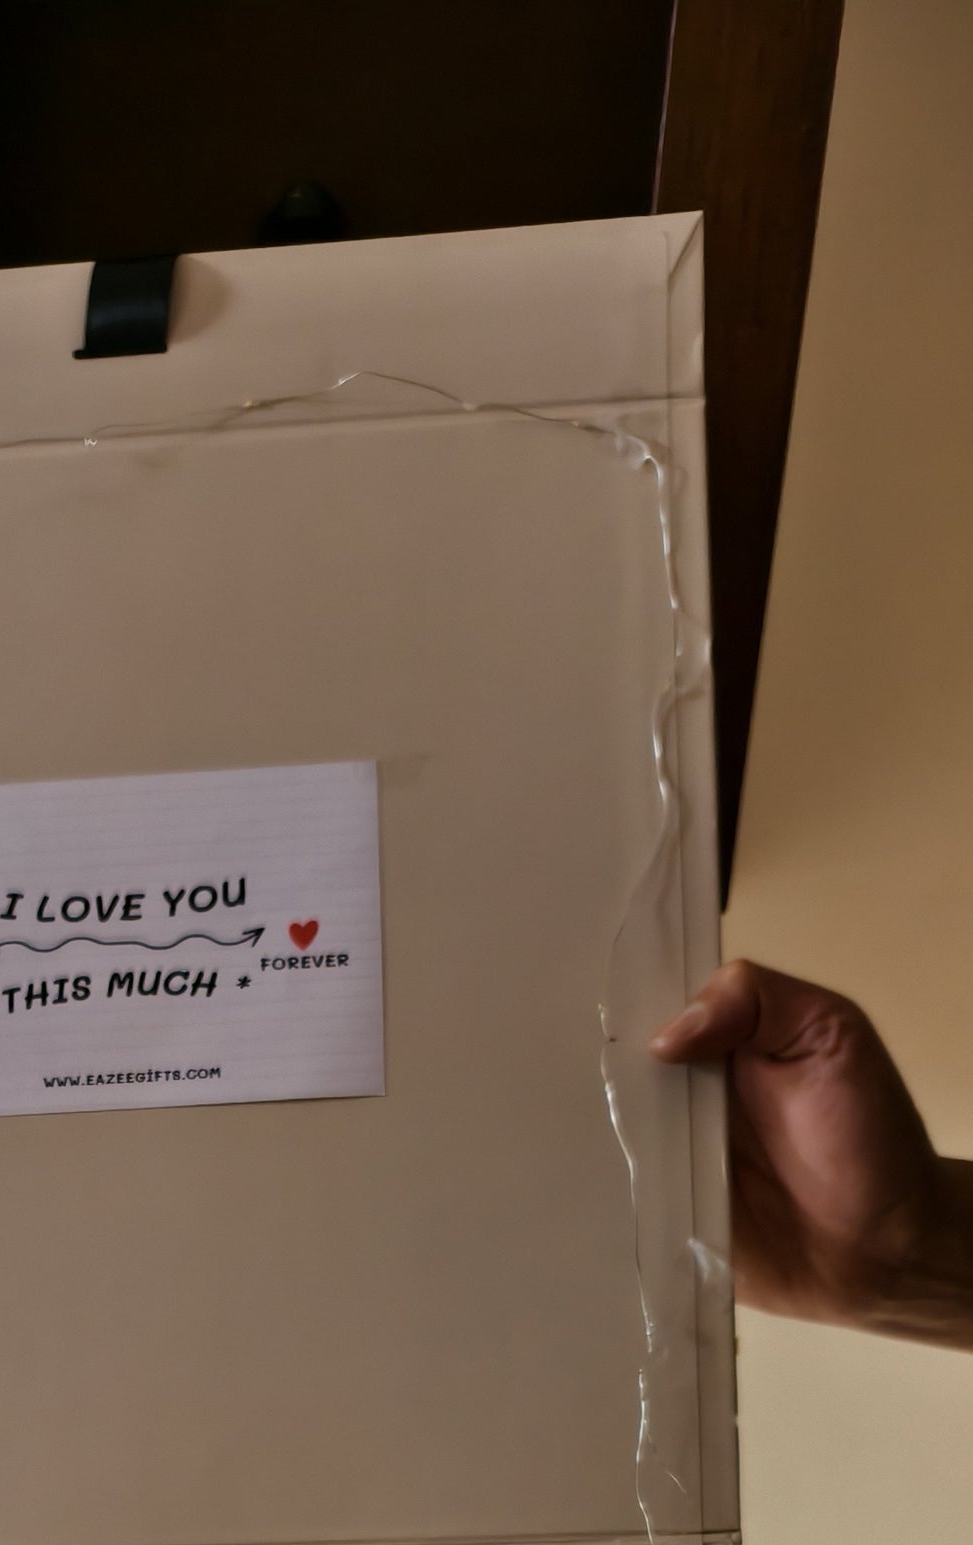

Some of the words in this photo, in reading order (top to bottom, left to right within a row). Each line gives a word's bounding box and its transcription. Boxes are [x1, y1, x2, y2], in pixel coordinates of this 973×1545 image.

[0, 893, 24, 921] I
[36, 892, 145, 922] LOVE
[161, 876, 247, 918] YOU
[260, 952, 349, 972] FOREVER
[2, 974, 91, 1014] THIS
[107, 970, 219, 998] MUCH
